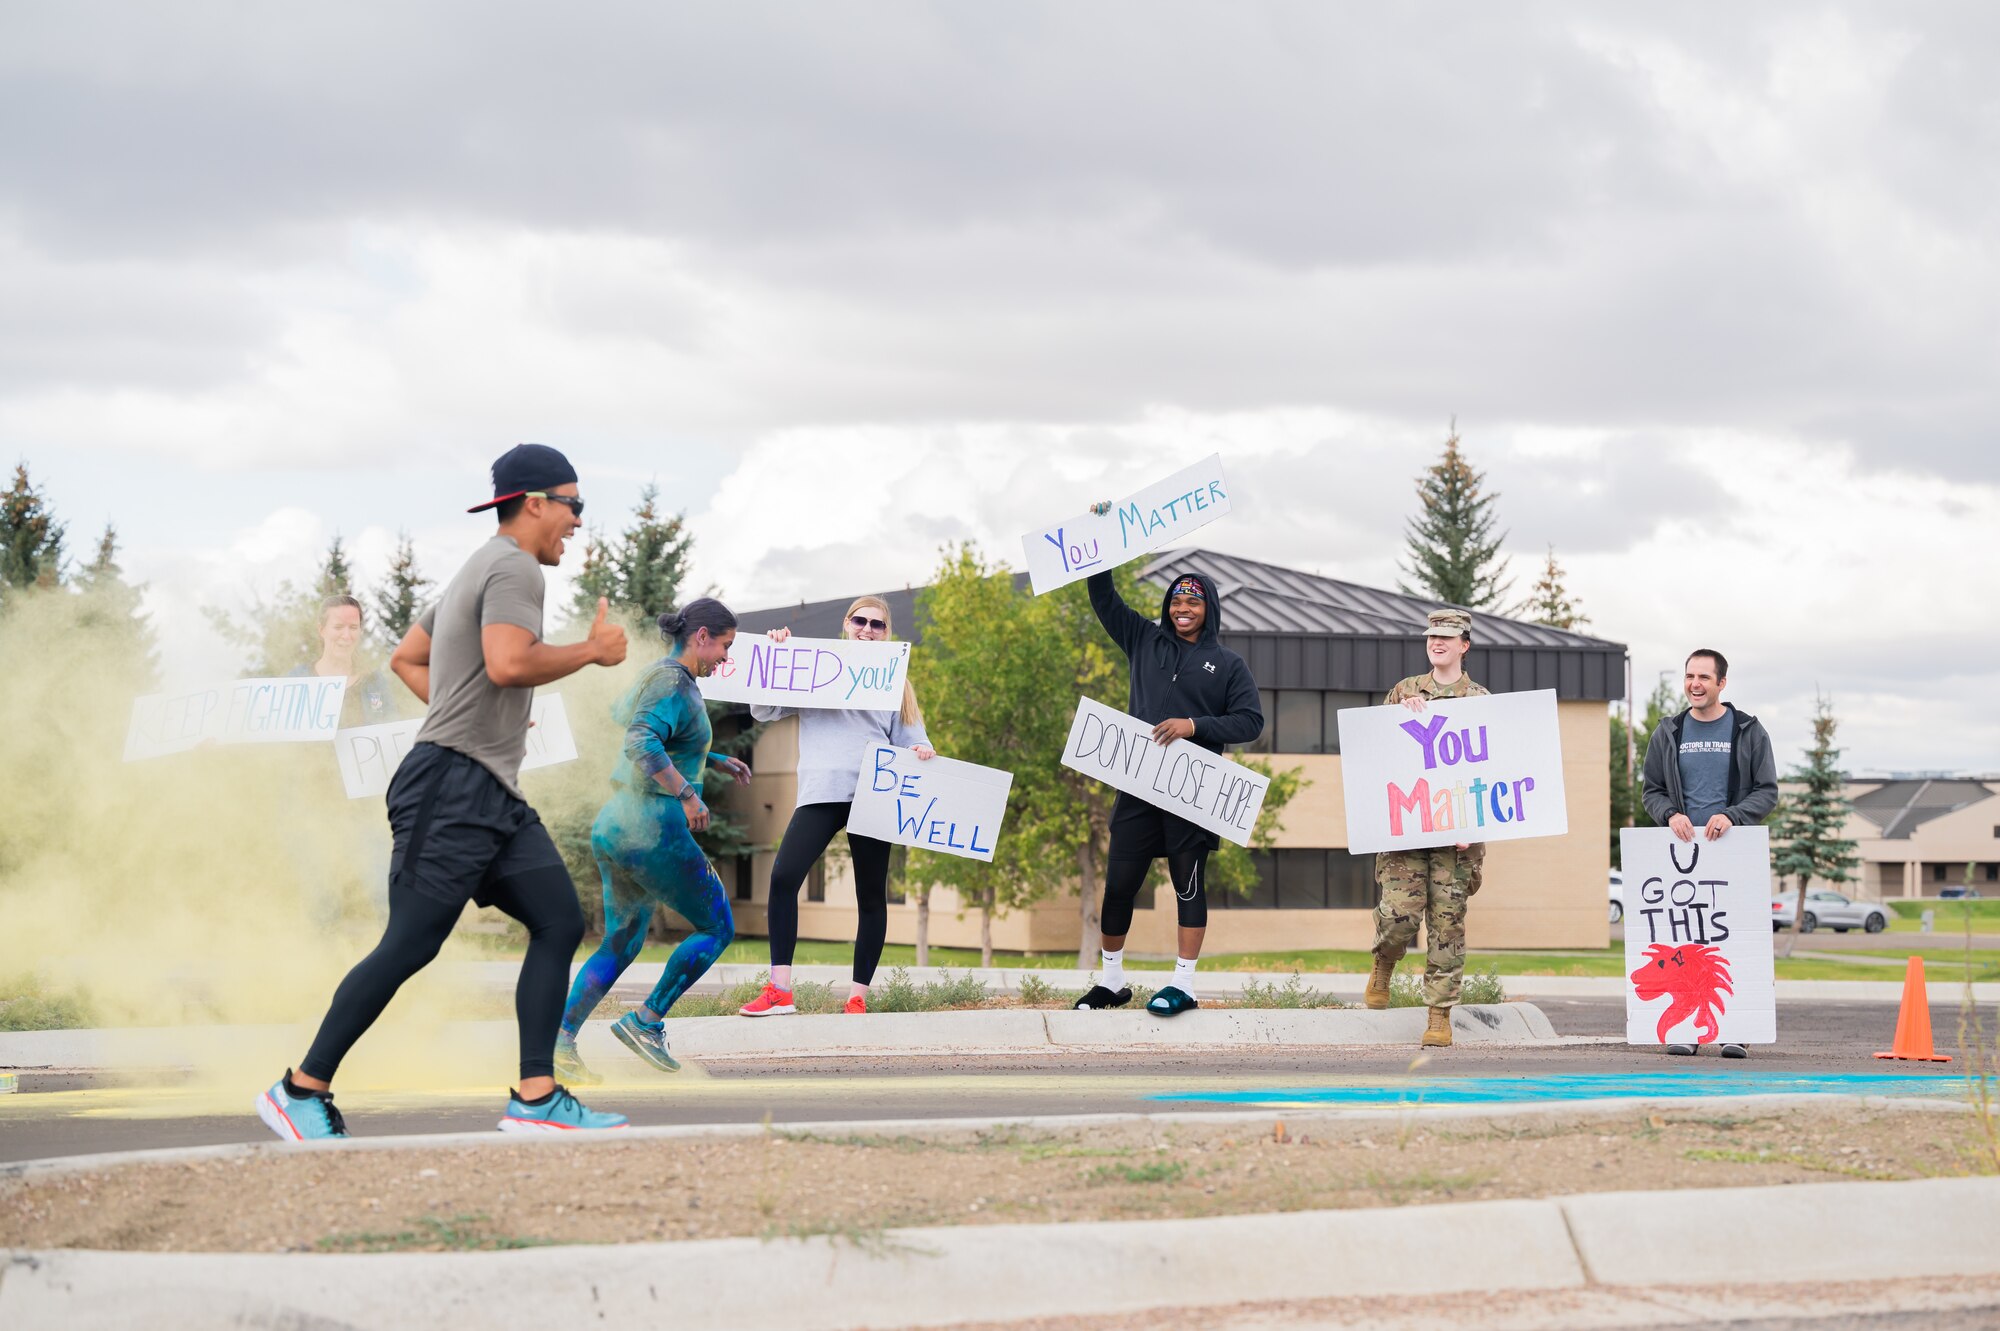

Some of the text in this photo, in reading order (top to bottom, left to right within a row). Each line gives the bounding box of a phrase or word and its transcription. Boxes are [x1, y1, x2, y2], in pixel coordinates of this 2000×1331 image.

[1118, 480, 1227, 549] MATTER
[711, 657, 736, 678] e
[746, 643, 843, 693] NEED
[134, 681, 342, 751] KEEP FIGHTING
[1679, 741, 1704, 750] OCTORS
[872, 748, 922, 799] BE
[1152, 743, 1216, 810] LOSE
[1210, 772, 1263, 831] HOPE
[896, 797, 990, 854] WELL
[1386, 776, 1535, 837] Matter
[1669, 842, 1700, 875] U
[1641, 876, 1729, 911] GOT
[1639, 903, 1730, 945] THIS
